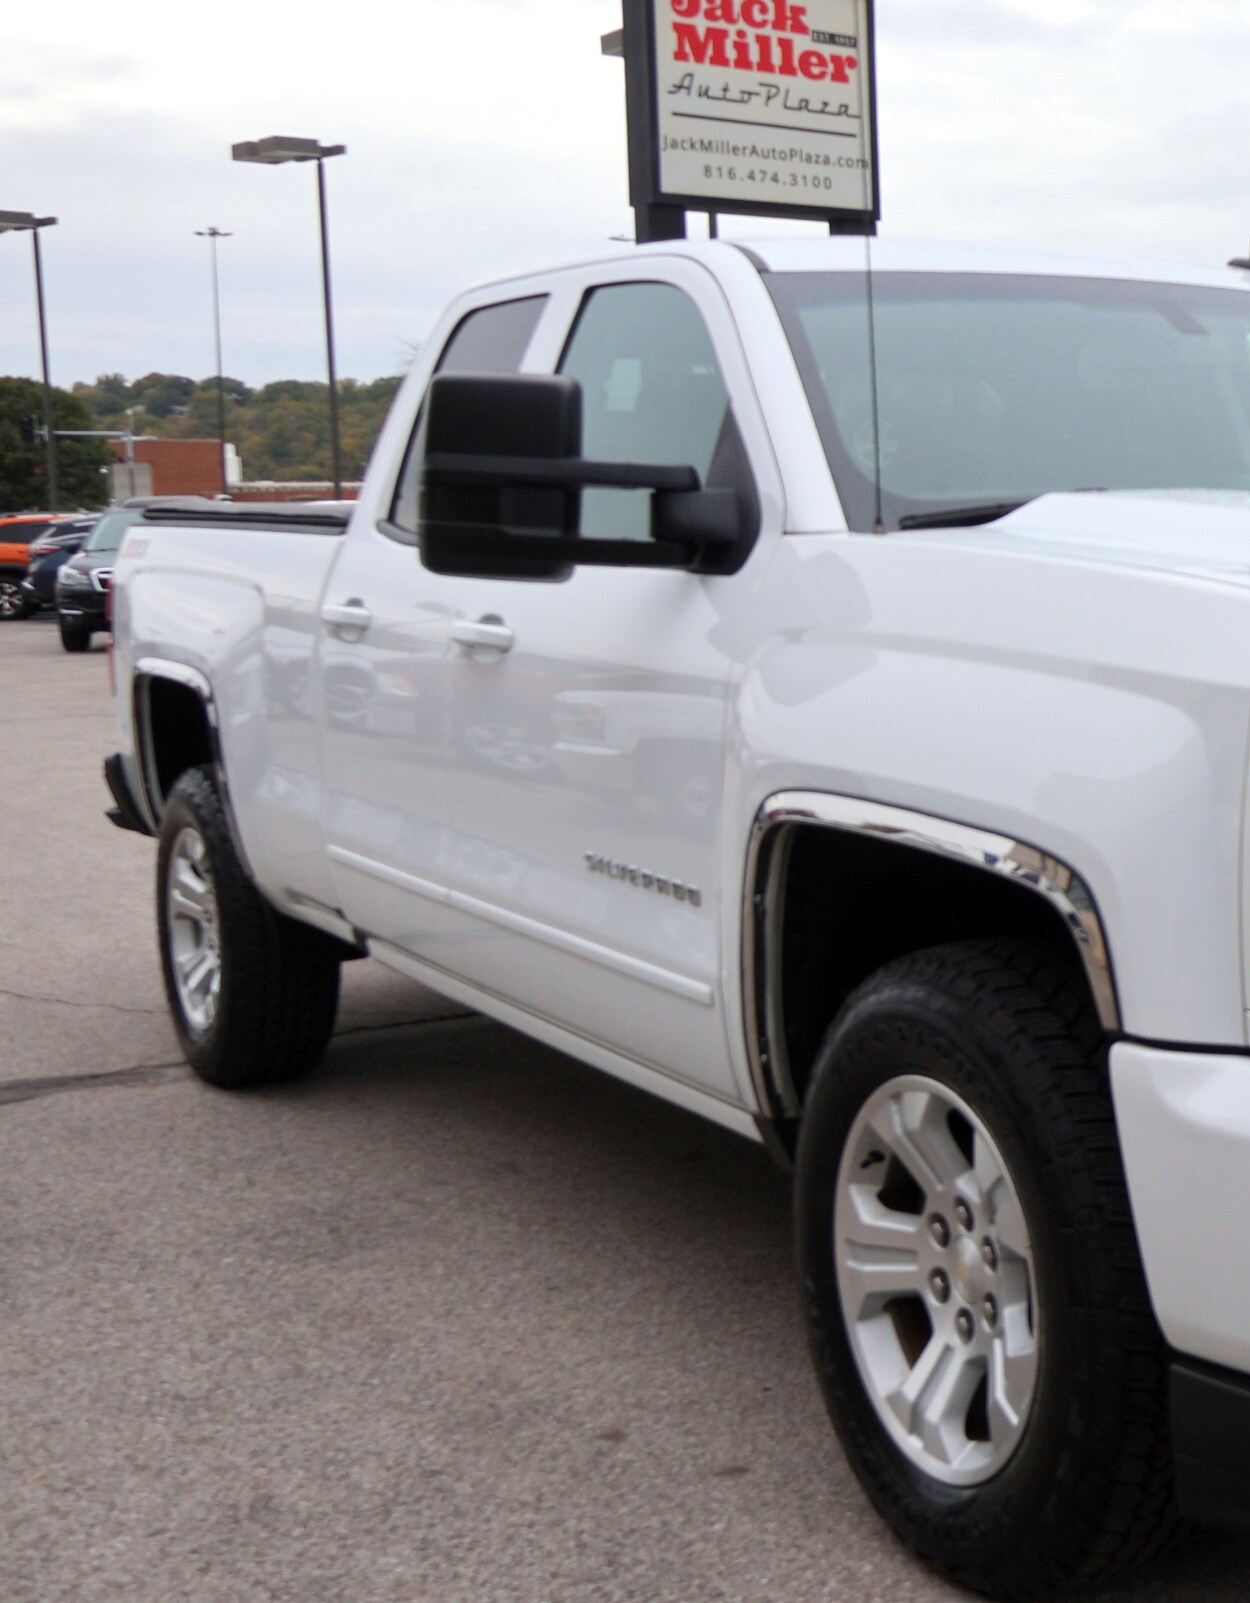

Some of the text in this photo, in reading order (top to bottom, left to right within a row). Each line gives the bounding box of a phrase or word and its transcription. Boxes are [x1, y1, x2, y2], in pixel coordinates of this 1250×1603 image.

[672, 22, 858, 84] Miller
[662, 135, 869, 170] JackMillerAutoPlaza.com
[703, 164, 832, 190] 816.474.3100
